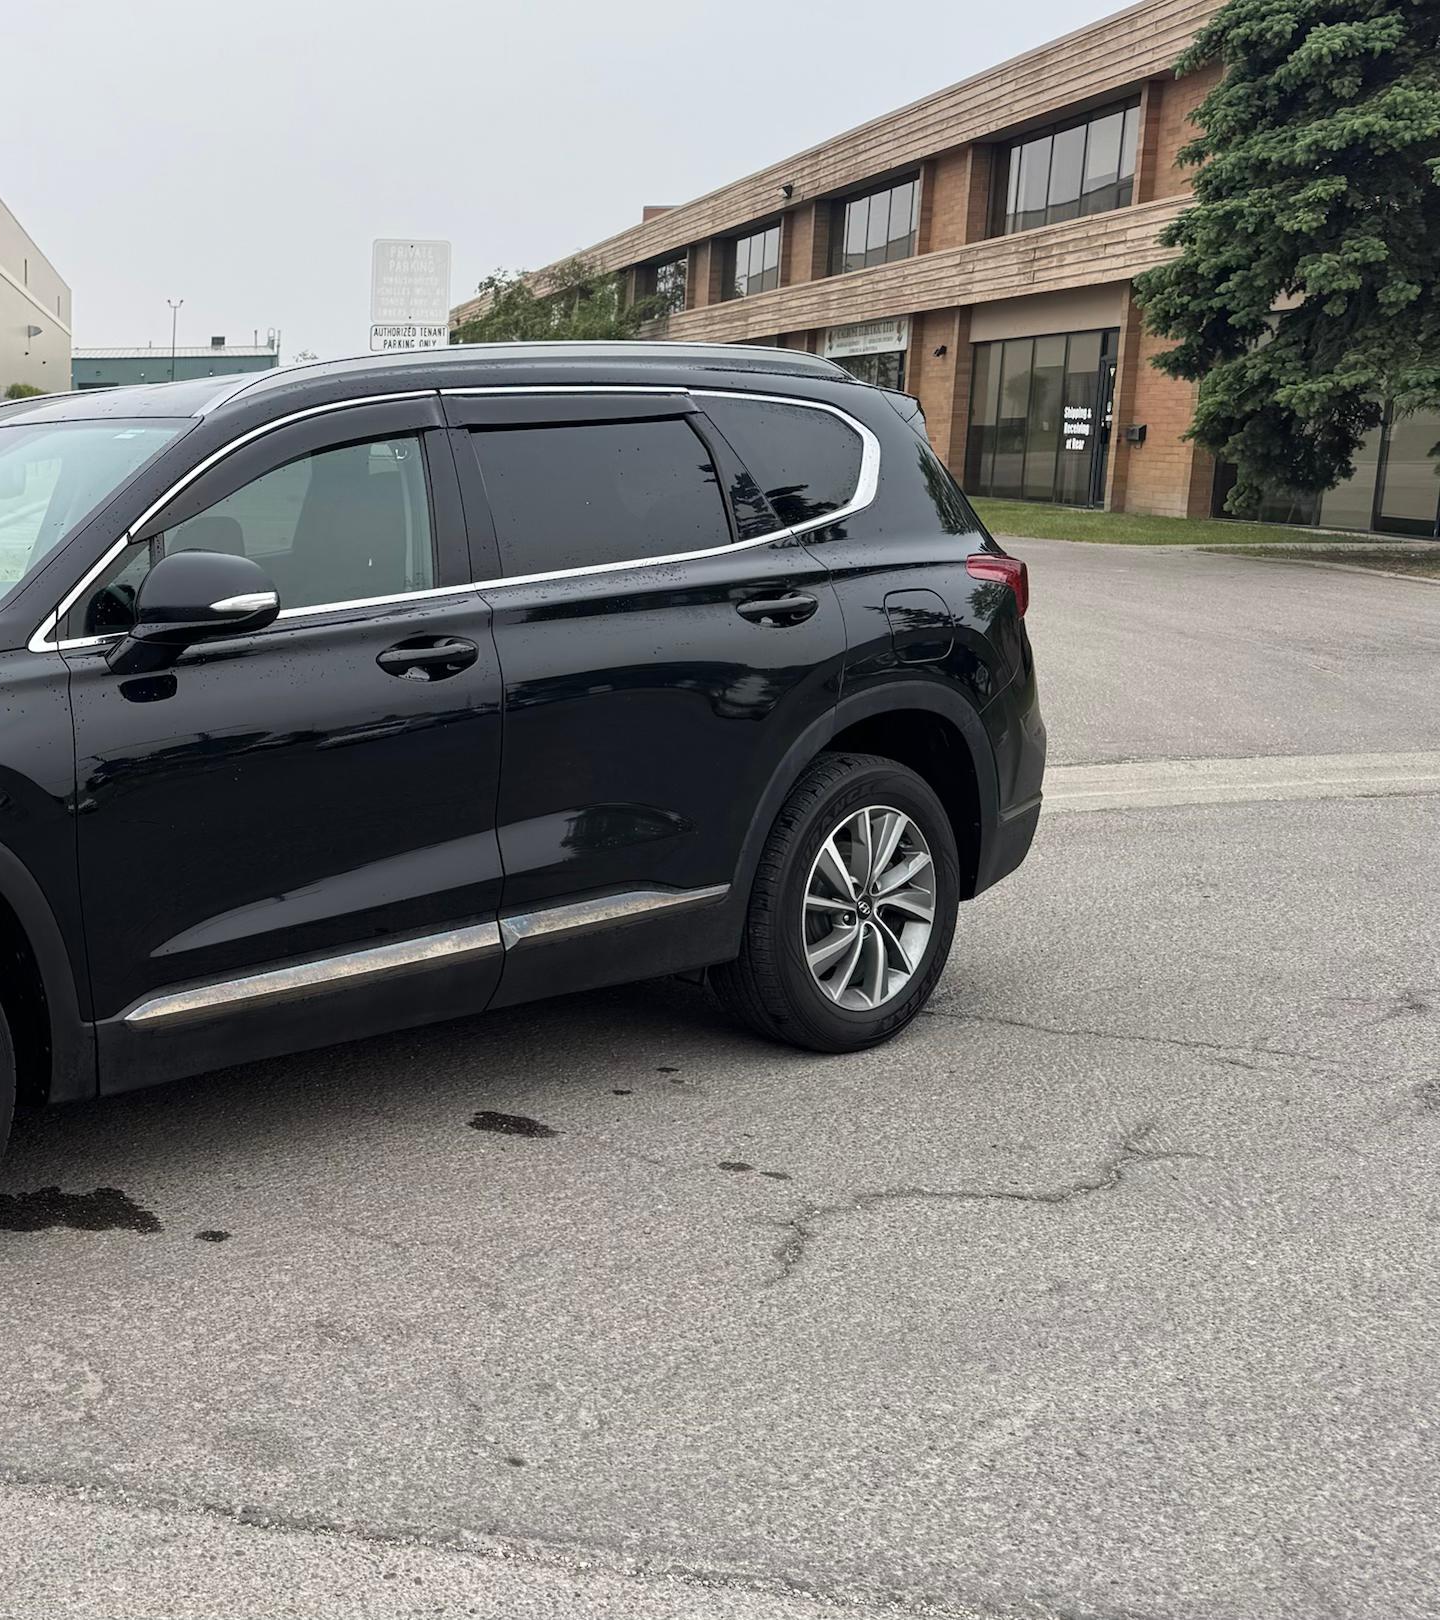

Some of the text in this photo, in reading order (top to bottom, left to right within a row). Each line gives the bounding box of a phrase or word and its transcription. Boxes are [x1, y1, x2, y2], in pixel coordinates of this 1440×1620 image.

[390, 246, 433, 259] PRIVATE
[389, 260, 435, 273] PARKING
[373, 327, 446, 337] AUTHORIZED TENANT
[383, 339, 437, 349] PARKING ONLY
[1064, 406, 1087, 420] Shipping
[1064, 422, 1089, 436] Receiving
